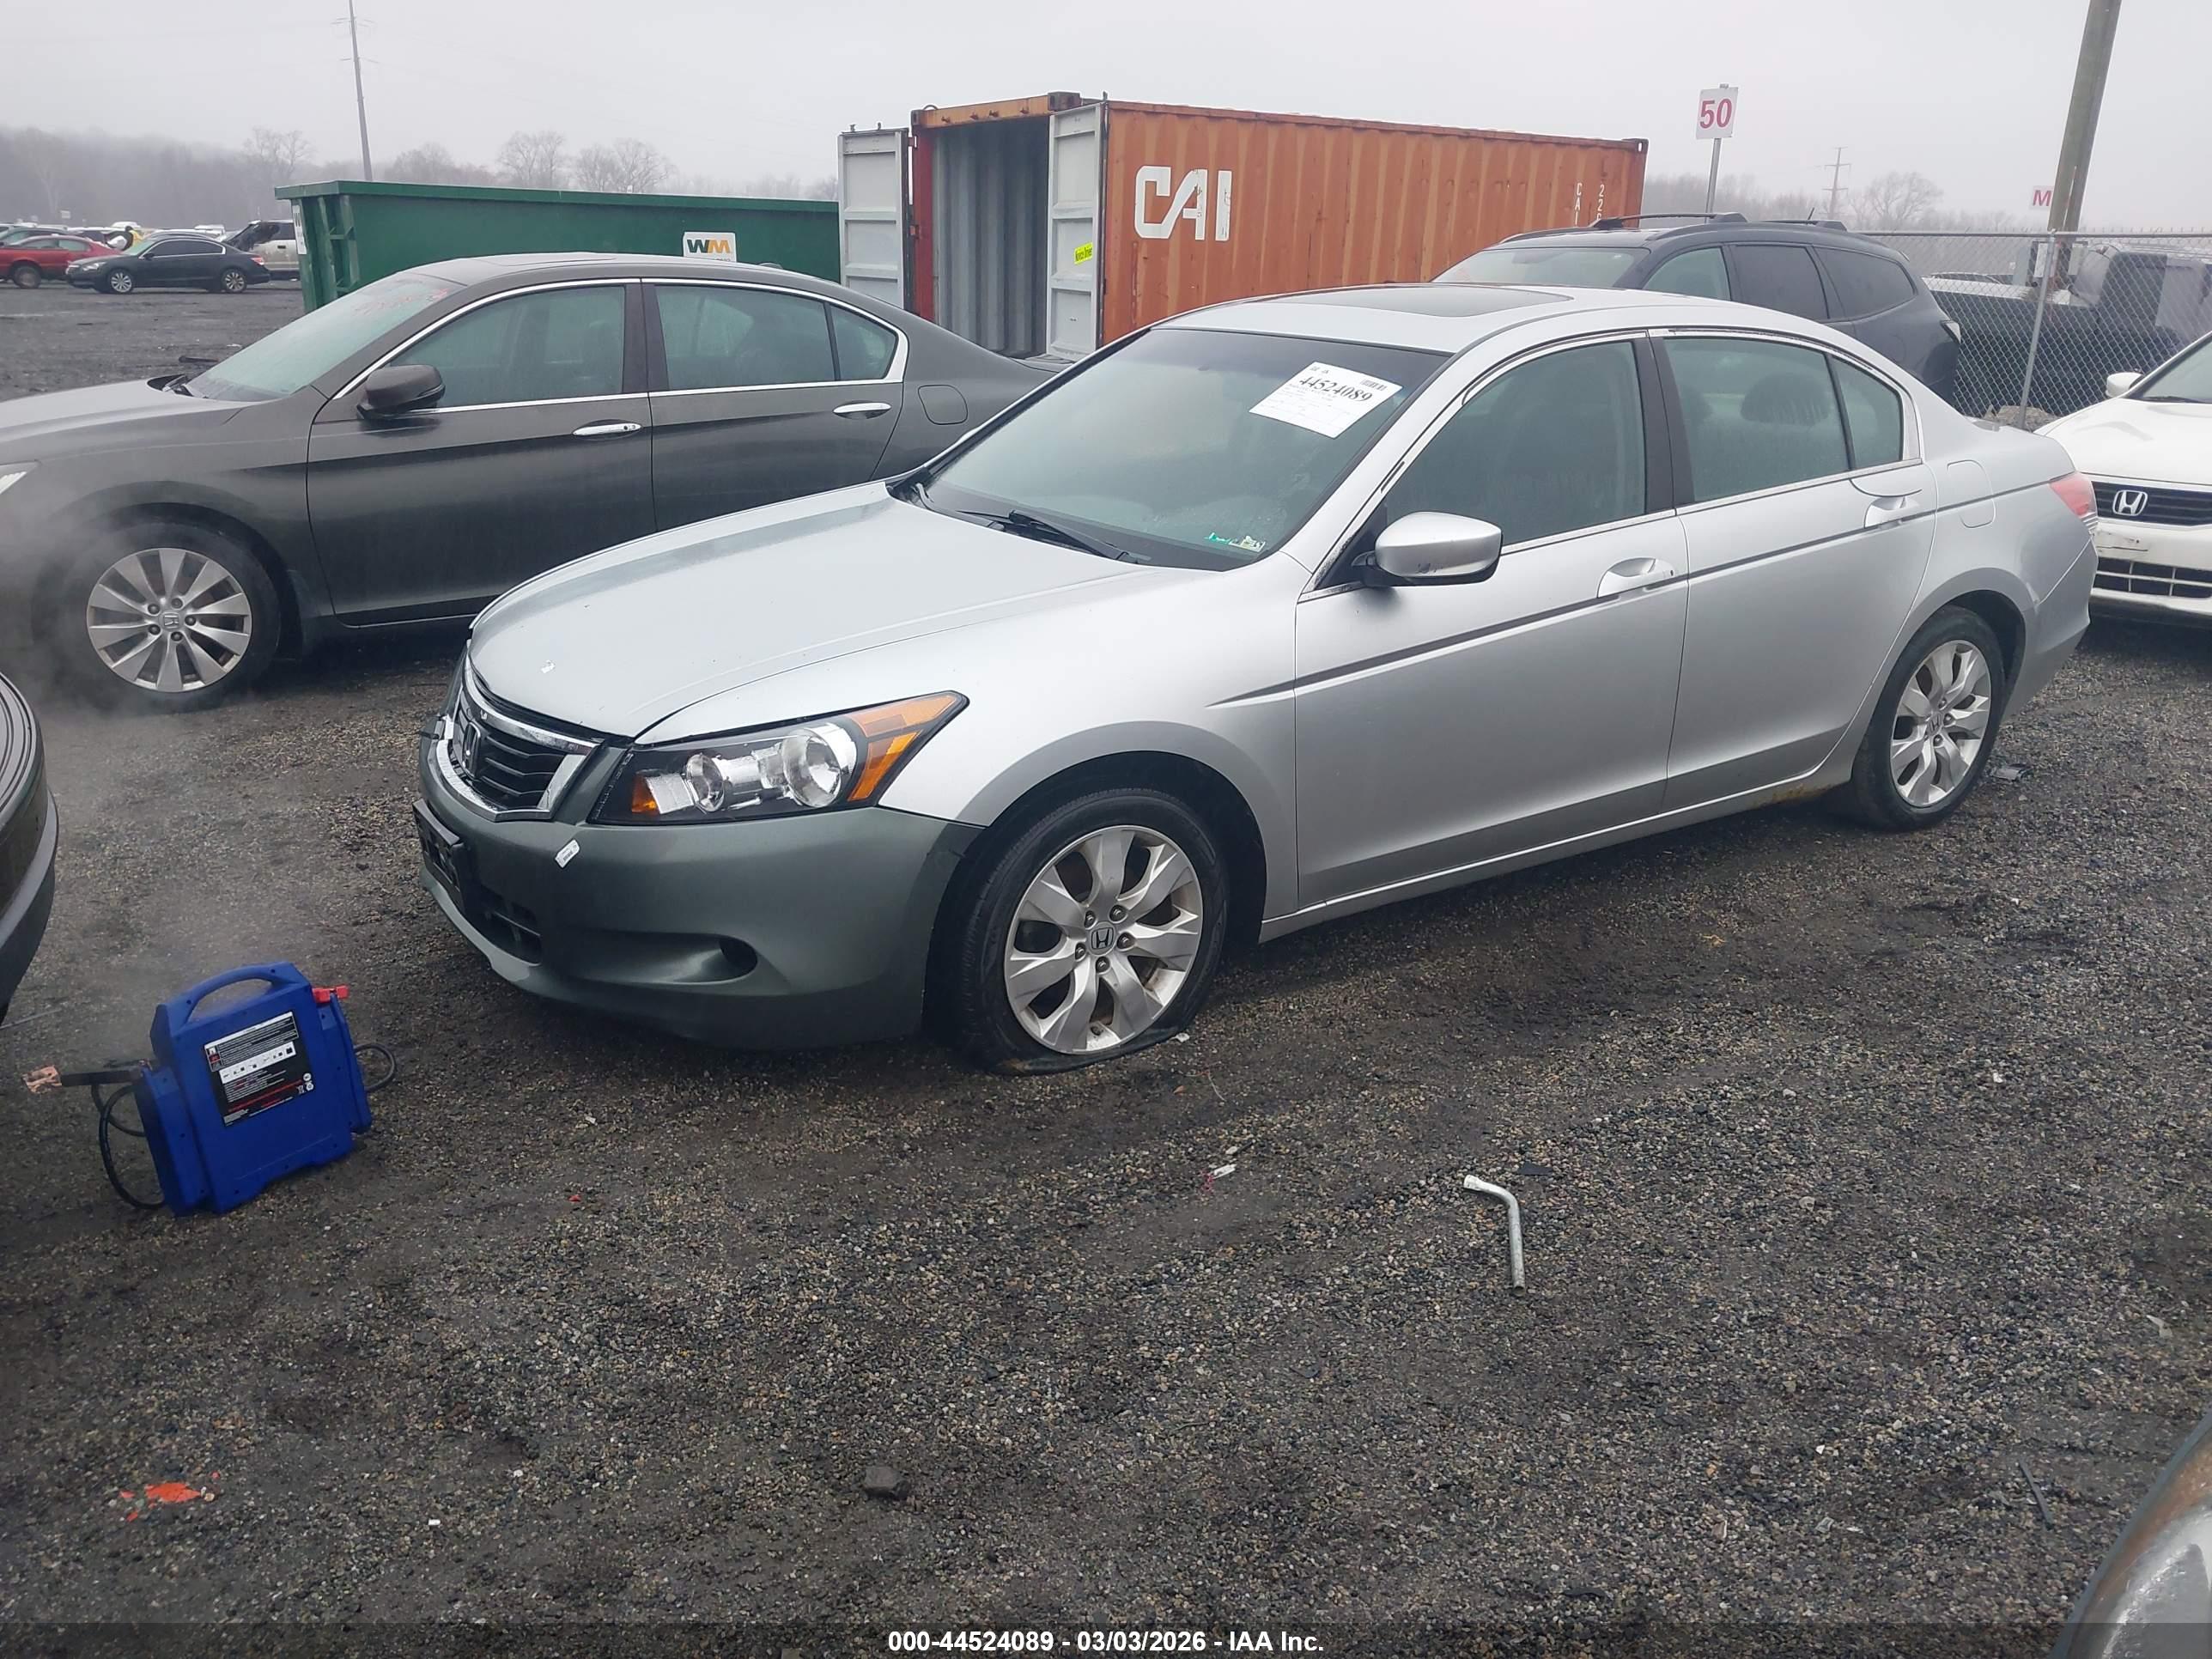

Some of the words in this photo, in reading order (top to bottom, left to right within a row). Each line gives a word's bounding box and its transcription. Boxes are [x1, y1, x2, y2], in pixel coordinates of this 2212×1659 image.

[1700, 98, 1732, 129] 50
[1134, 165, 1232, 241] CAI
[687, 239, 731, 253] WM
[1298, 375, 1373, 403] 44524089
